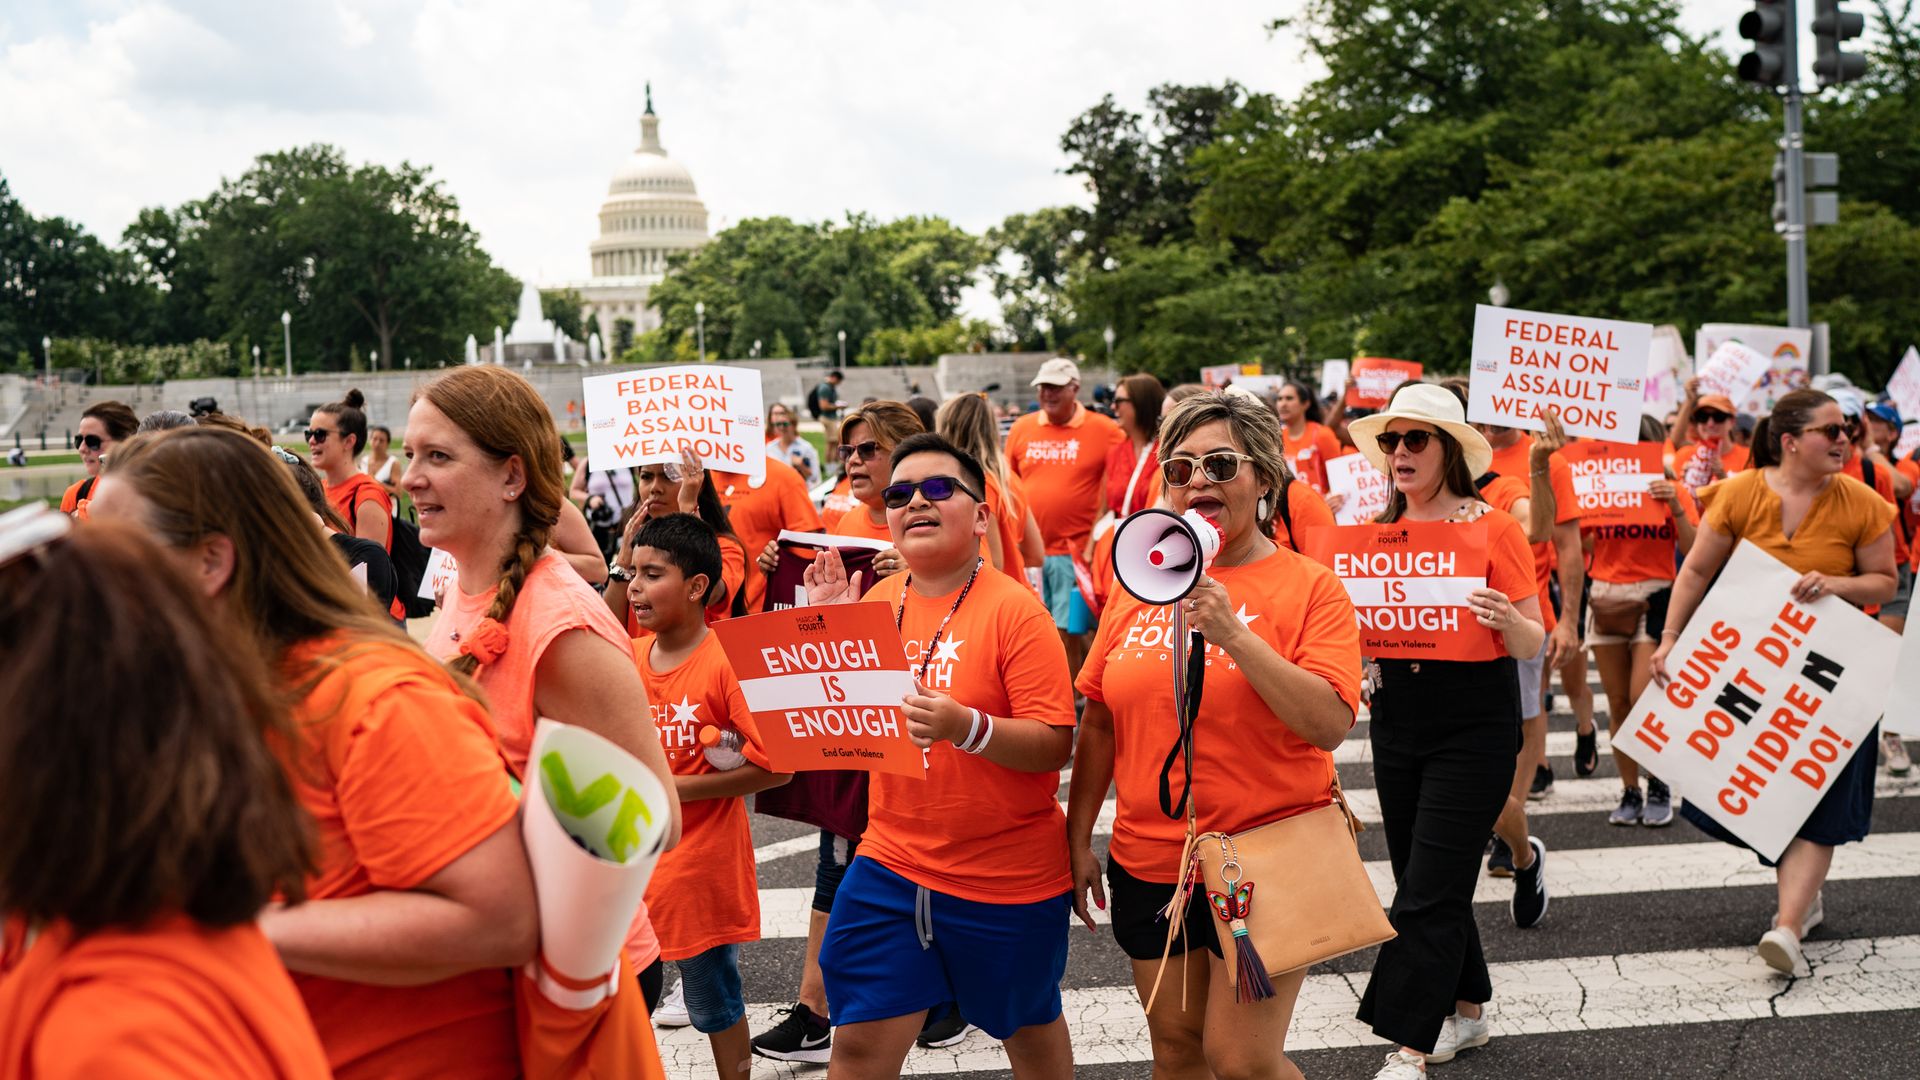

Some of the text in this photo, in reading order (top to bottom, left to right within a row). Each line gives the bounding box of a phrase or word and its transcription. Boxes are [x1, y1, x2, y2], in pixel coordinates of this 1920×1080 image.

[1504, 319, 1619, 351] FEDERAL
[1510, 346, 1609, 375] BAN ON
[617, 374, 733, 396] FEDERAL
[1502, 372, 1612, 402] ASSAULT
[627, 394, 727, 415] BAN ON
[1491, 395, 1617, 430] WEAPONS
[624, 416, 734, 437] ASSAULT
[614, 437, 745, 463] WEAPONS
[1026, 448, 1078, 460] FOURTH
[1568, 458, 1641, 476] NOUGH
[1378, 536, 1408, 544] FOURTH
[1334, 552, 1455, 577] ENOUGH
[1384, 581, 1406, 603] IS
[798, 622, 827, 631] FOURTH
[1355, 608, 1459, 632] NOUGH
[761, 639, 881, 674] ENOUGH
[1366, 640, 1437, 649] End Gun Violence
[820, 675, 846, 703] IS
[1634, 620, 1741, 754] IF GUNS
[785, 709, 899, 738] ENOUGH
[1686, 667, 1767, 761] DONT
[822, 747, 884, 759] End Gun Violence
[1790, 724, 1854, 791] DO!
